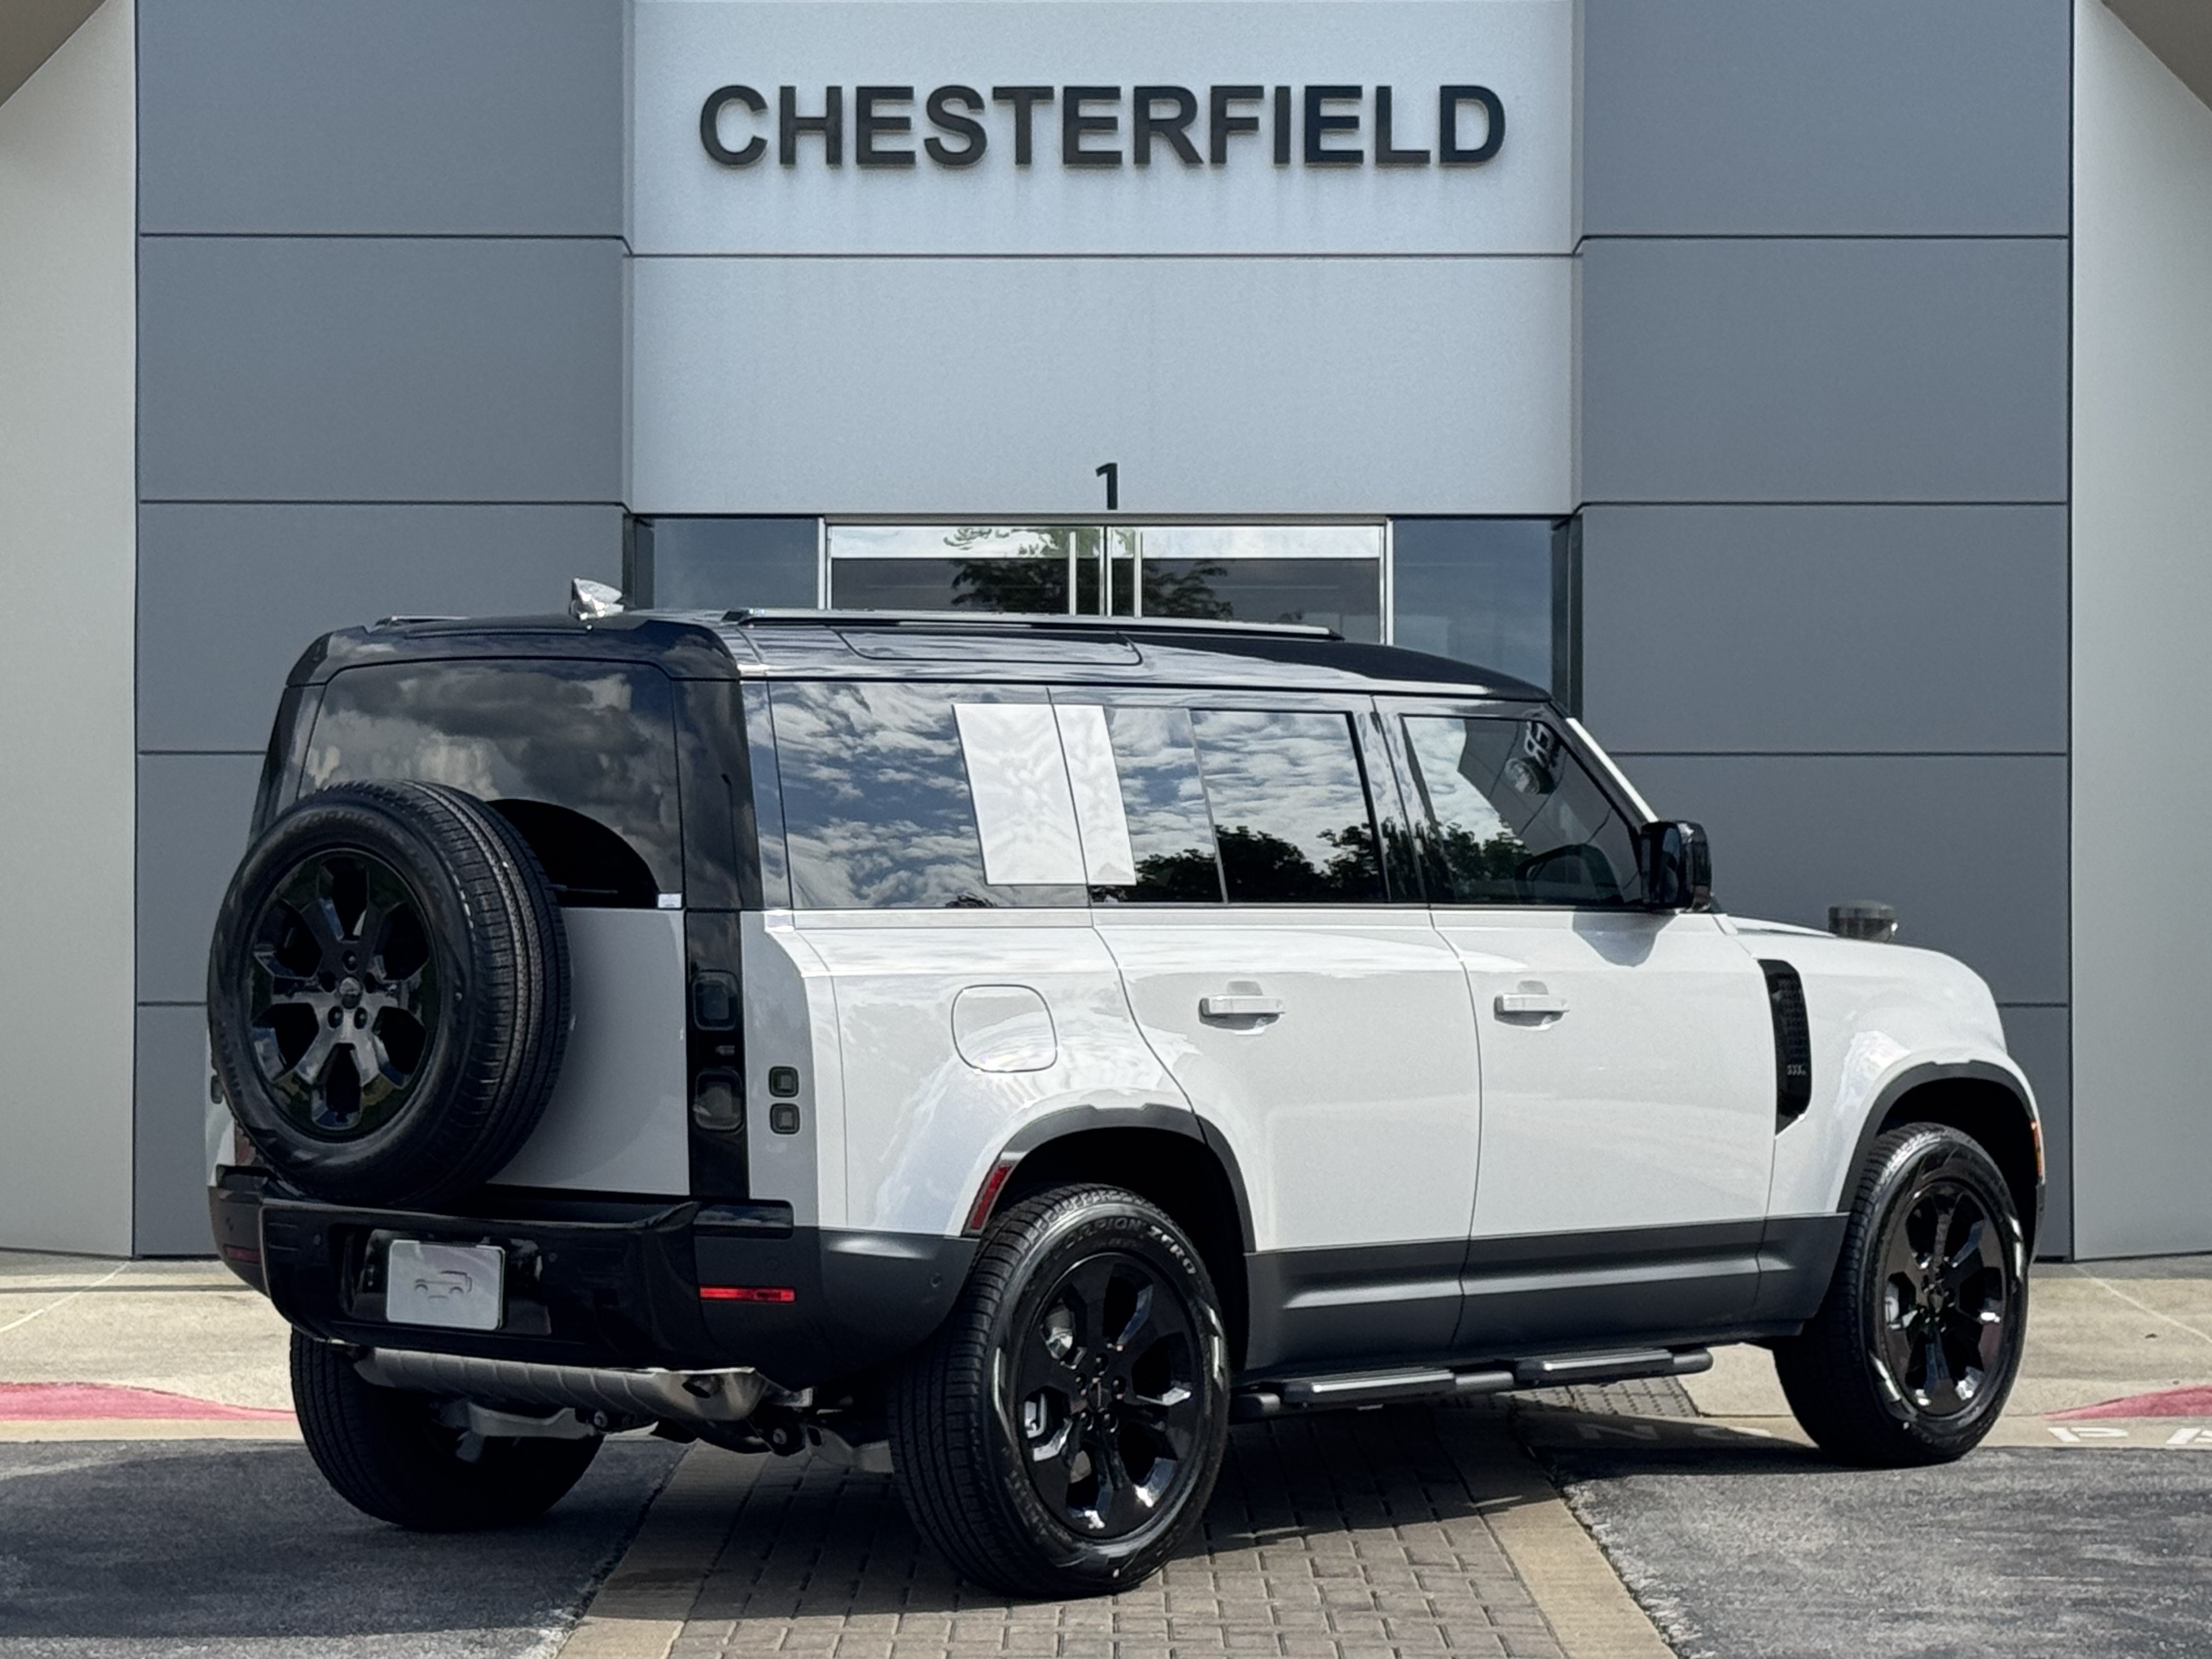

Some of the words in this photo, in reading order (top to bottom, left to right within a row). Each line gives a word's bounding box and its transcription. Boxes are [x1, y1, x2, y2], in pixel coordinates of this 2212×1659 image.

[699, 85, 1505, 167] CHESTERFIELD
[1096, 462, 1118, 510] 1
[1147, 1224, 1197, 1274] ZERO
